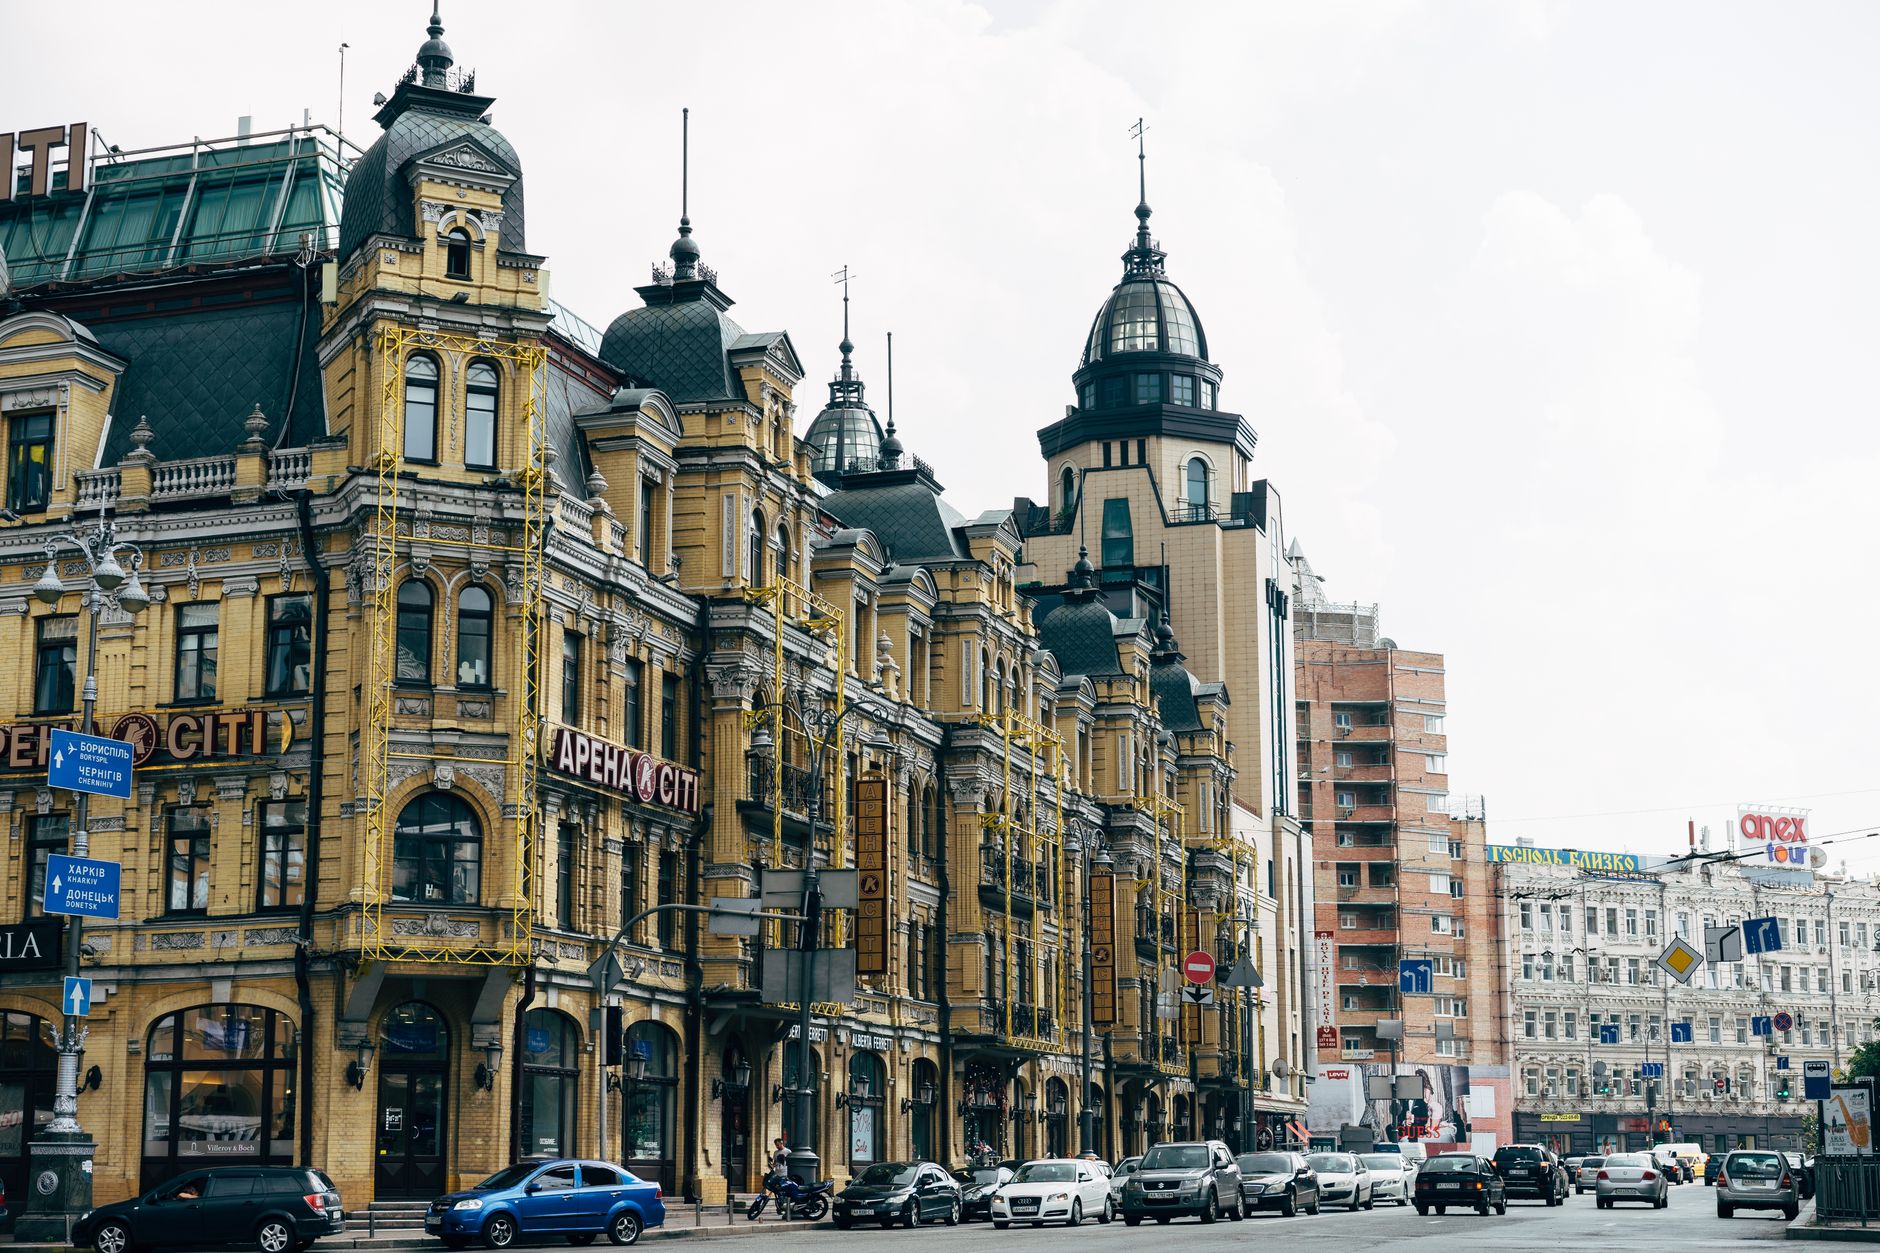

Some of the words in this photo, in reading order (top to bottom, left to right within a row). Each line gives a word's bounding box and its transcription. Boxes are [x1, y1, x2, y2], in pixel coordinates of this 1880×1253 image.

[80, 742, 130, 759] БОРИСПІЛЬ
[79, 753, 108, 764] BORYSPIL
[558, 730, 633, 793] АРЕНА
[79, 766, 122, 781] ЧЕРНІГІВ
[78, 777, 113, 788] CHERNIHIV
[1741, 814, 1807, 842] anex
[1493, 846, 1562, 865] ГОСПОДЬ
[1569, 851, 1635, 871] БЛИЗКО
[1766, 842, 1807, 864] tour
[68, 864, 105, 877] ХАРКІВ
[67, 876, 98, 885] KHARKIV
[66, 890, 114, 903] ДОНЕЦЬК
[66, 901, 98, 910] DONETSK
[852, 1033, 872, 1048] ALBERTA
[873, 1036, 894, 1050] FERRETTI
[1396, 1126, 1441, 1139] GUESS
[207, 1144, 231, 1152] Villeroy
